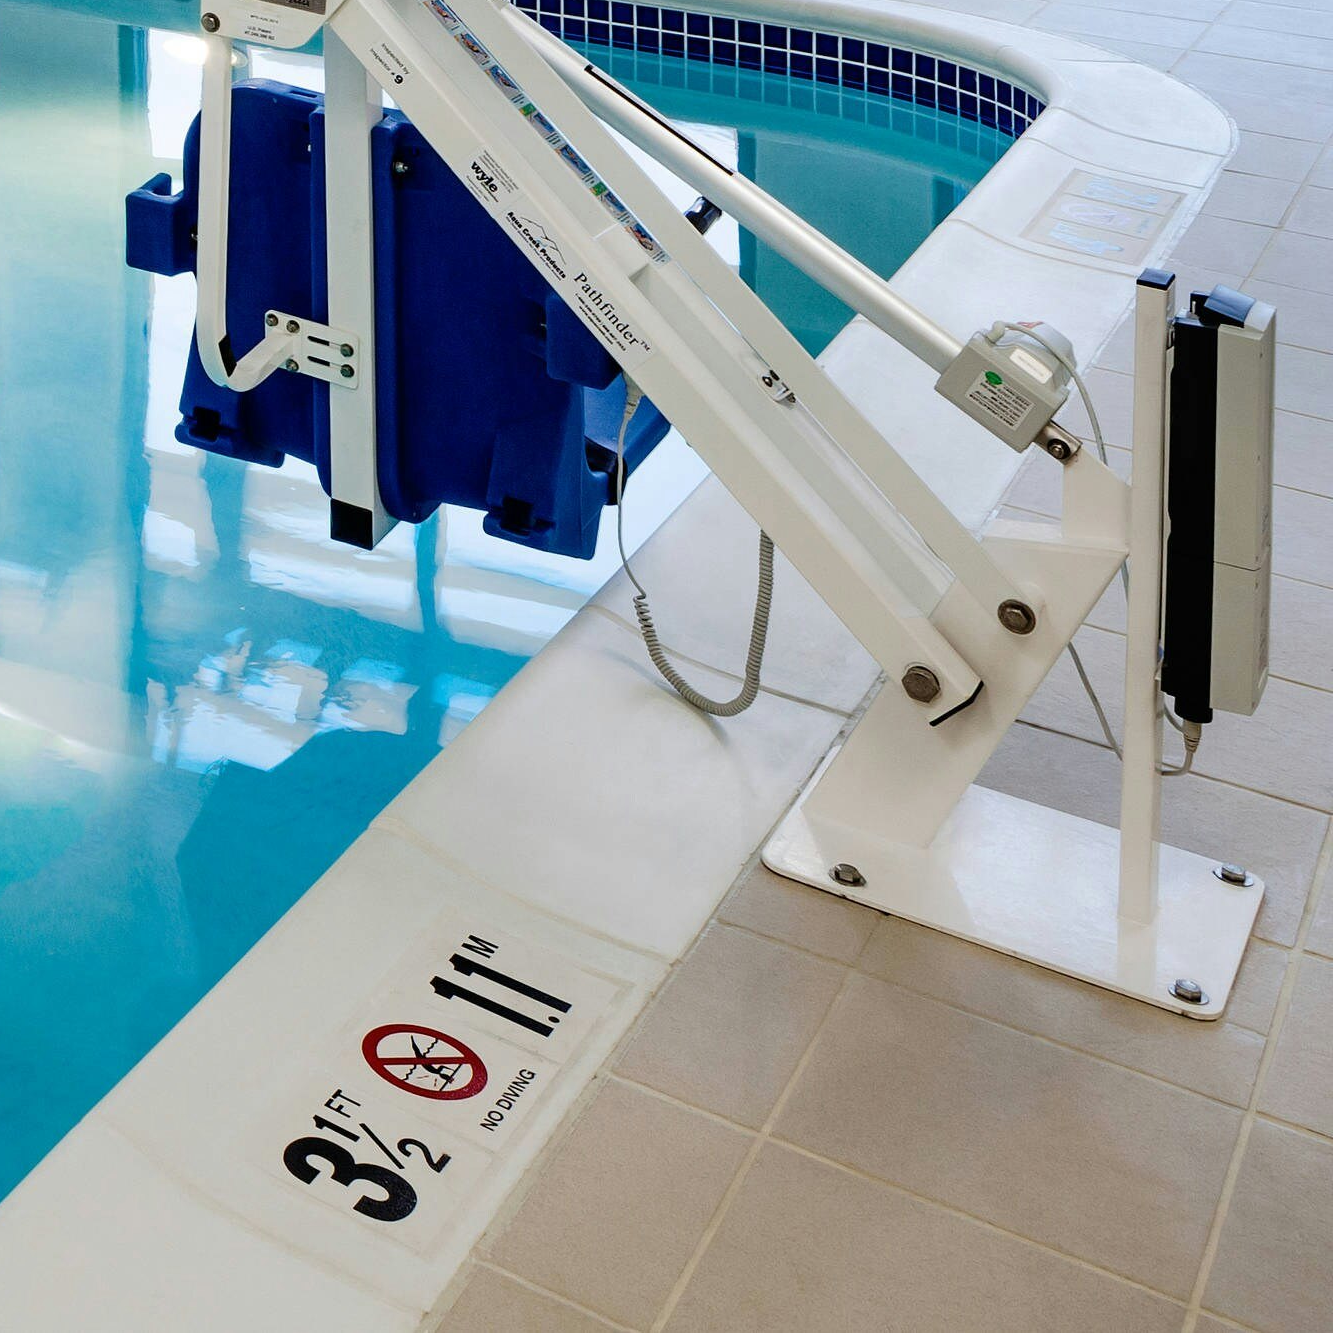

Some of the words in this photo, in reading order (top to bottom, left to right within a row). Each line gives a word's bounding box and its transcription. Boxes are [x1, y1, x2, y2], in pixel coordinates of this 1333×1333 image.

[471, 161, 498, 193] wyle
[507, 211, 523, 229] Aqua
[522, 228, 540, 249] Creek
[540, 247, 566, 279] Products
[480, 1110, 504, 1132] NO
[496, 1068, 536, 1110] DIVING
